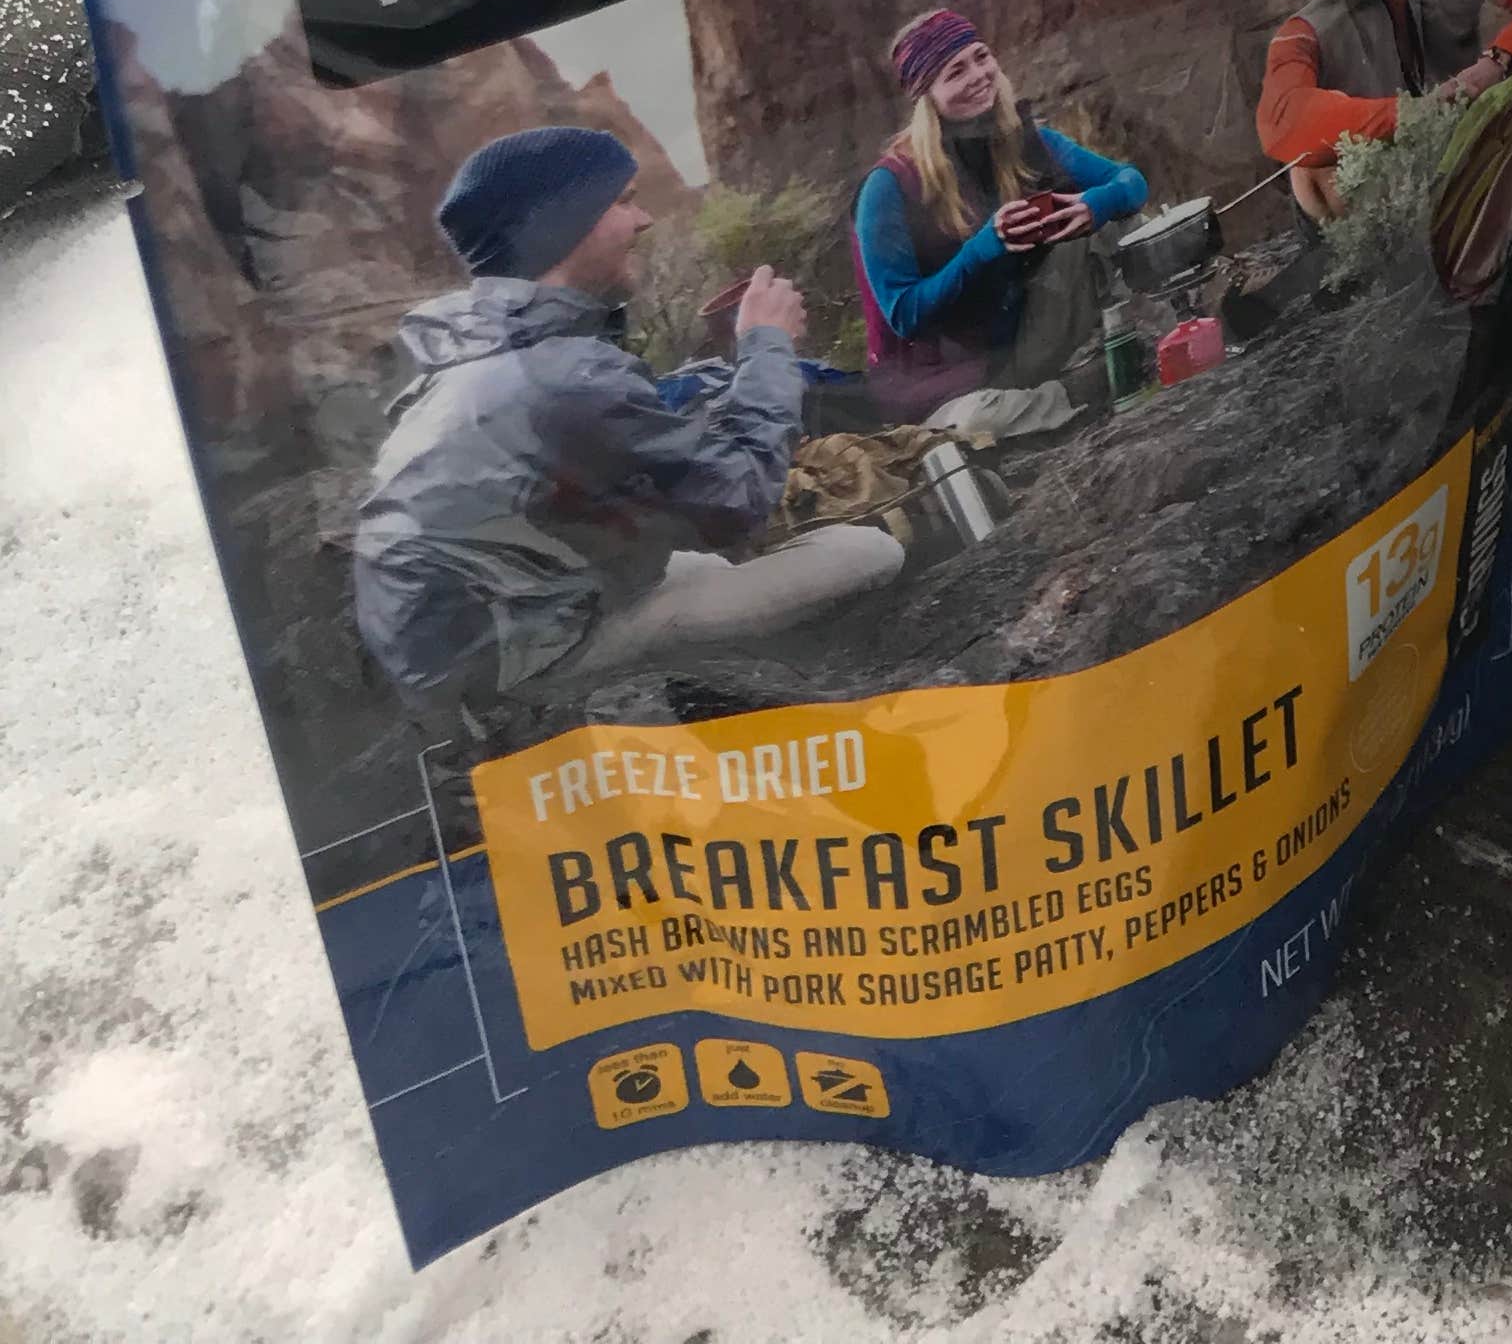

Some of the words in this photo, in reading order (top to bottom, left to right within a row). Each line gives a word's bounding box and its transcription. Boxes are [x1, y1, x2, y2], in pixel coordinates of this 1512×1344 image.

[1357, 521, 1439, 619] 13g
[529, 749, 700, 823] FREEZE
[719, 729, 867, 804] DRIED
[548, 815, 1007, 928] BREAKFAST
[1042, 684, 1305, 874] SKILLET
[561, 925, 650, 972] HASH
[662, 912, 792, 961] BROWNS
[803, 927, 867, 959] AND
[880, 891, 1066, 958] SCRAMBLED
[1078, 865, 1154, 915] EGGS
[569, 968, 668, 1007] MIXED
[676, 957, 755, 998] WITH
[762, 971, 846, 1006] PORK
[858, 958, 1005, 1007] SAUSAGE
[1015, 927, 1115, 985] PATTY,
[1124, 867, 1244, 954] PEPPERS
[1252, 849, 1267, 883] &
[1276, 777, 1351, 867] ONIONS
[1261, 918, 1317, 998] NET
[633, 1048, 669, 1065] than
[712, 1090, 740, 1102] add
[743, 1091, 783, 1103] water
